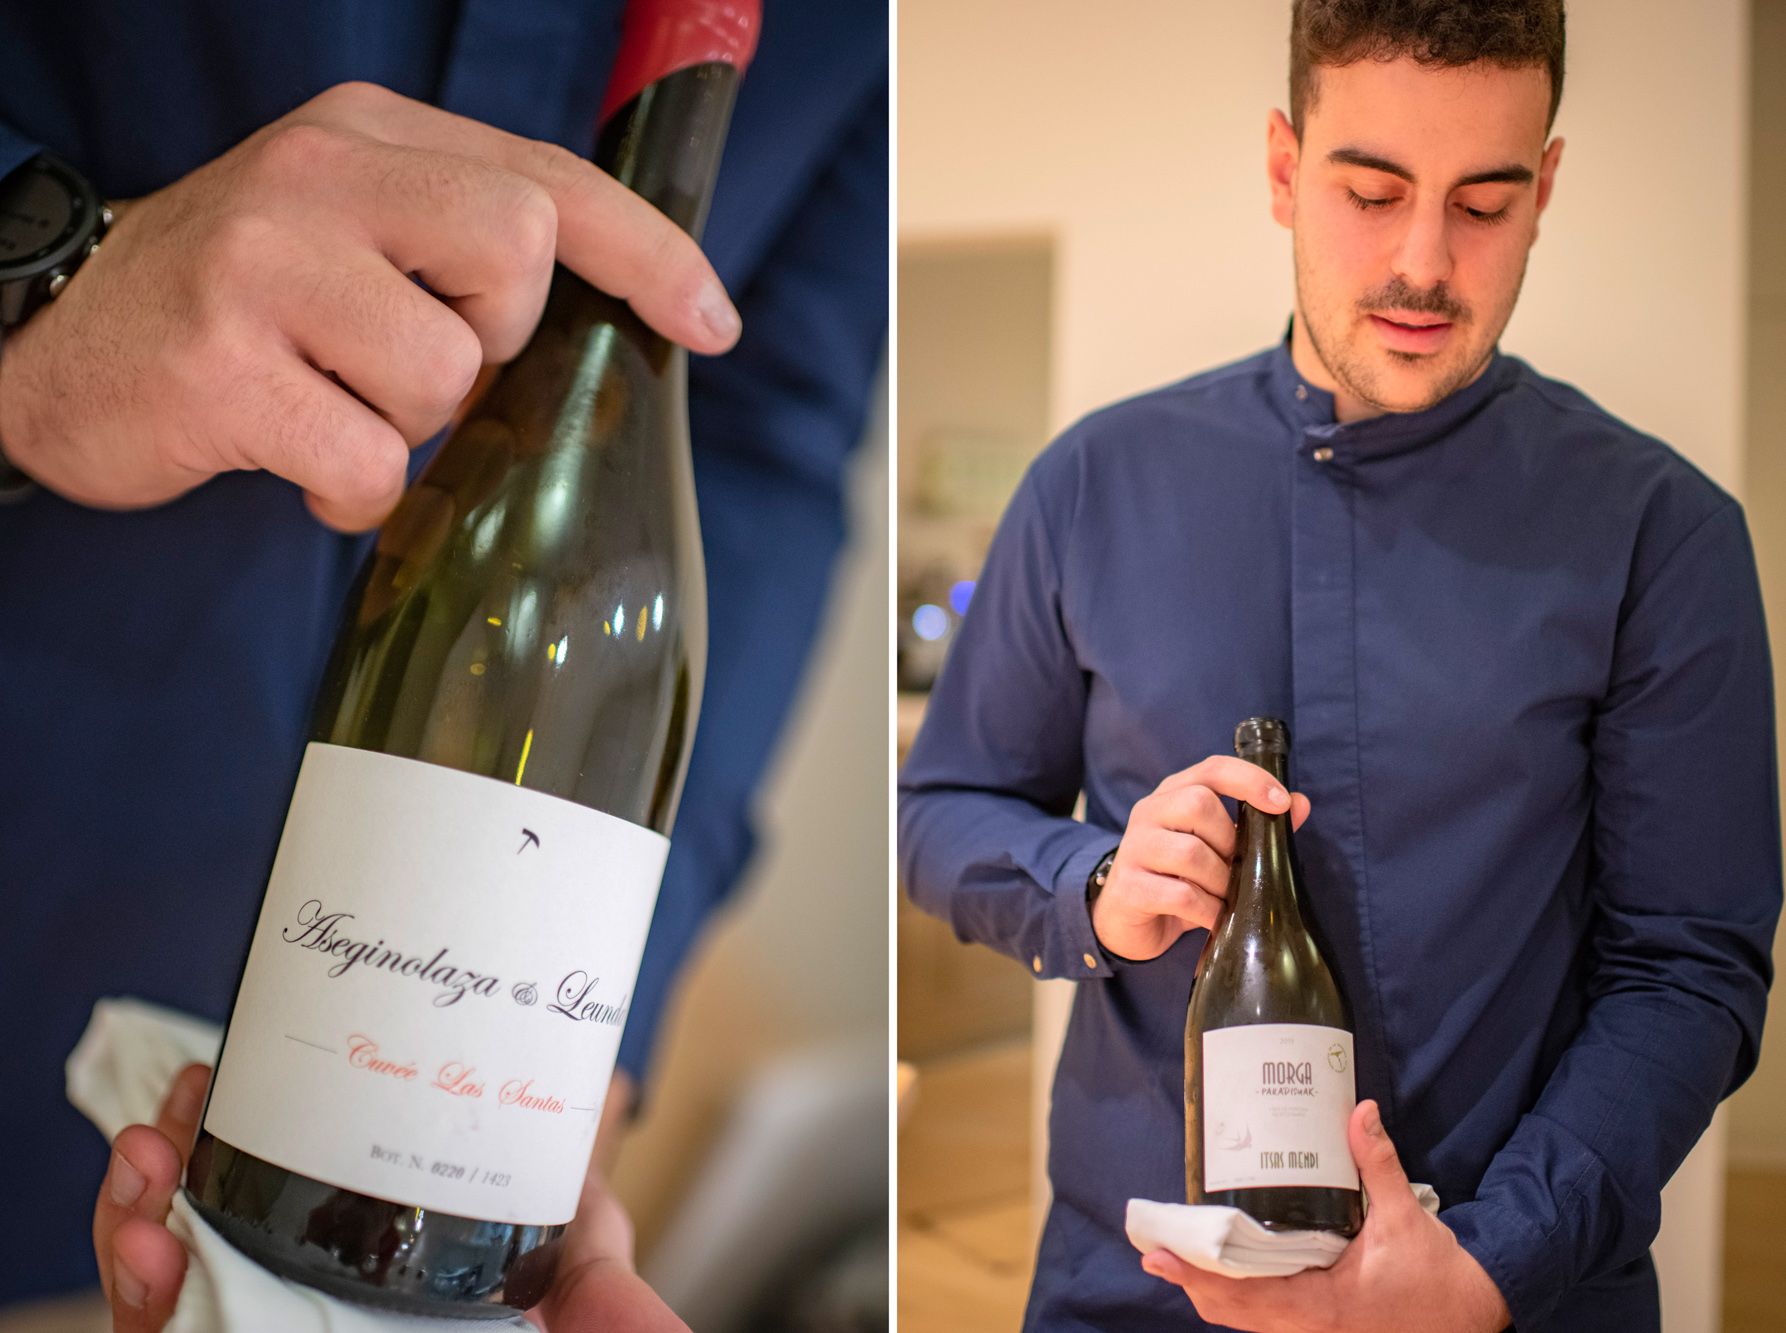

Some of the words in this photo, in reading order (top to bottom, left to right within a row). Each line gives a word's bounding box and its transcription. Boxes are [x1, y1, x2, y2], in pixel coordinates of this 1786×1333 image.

[282, 899, 502, 1008] Aseginolaza
[511, 980, 538, 1007] &
[346, 1034, 418, 1082] Cuvée
[431, 1061, 483, 1099] Las
[499, 1079, 564, 1115] Santas
[1262, 1061, 1312, 1085] MORGA
[430, 1160, 465, 1180] 0220
[482, 1170, 512, 1188] 1423
[1260, 1151, 1284, 1169] ITSAS
[1288, 1151, 1319, 1169] MENDI
